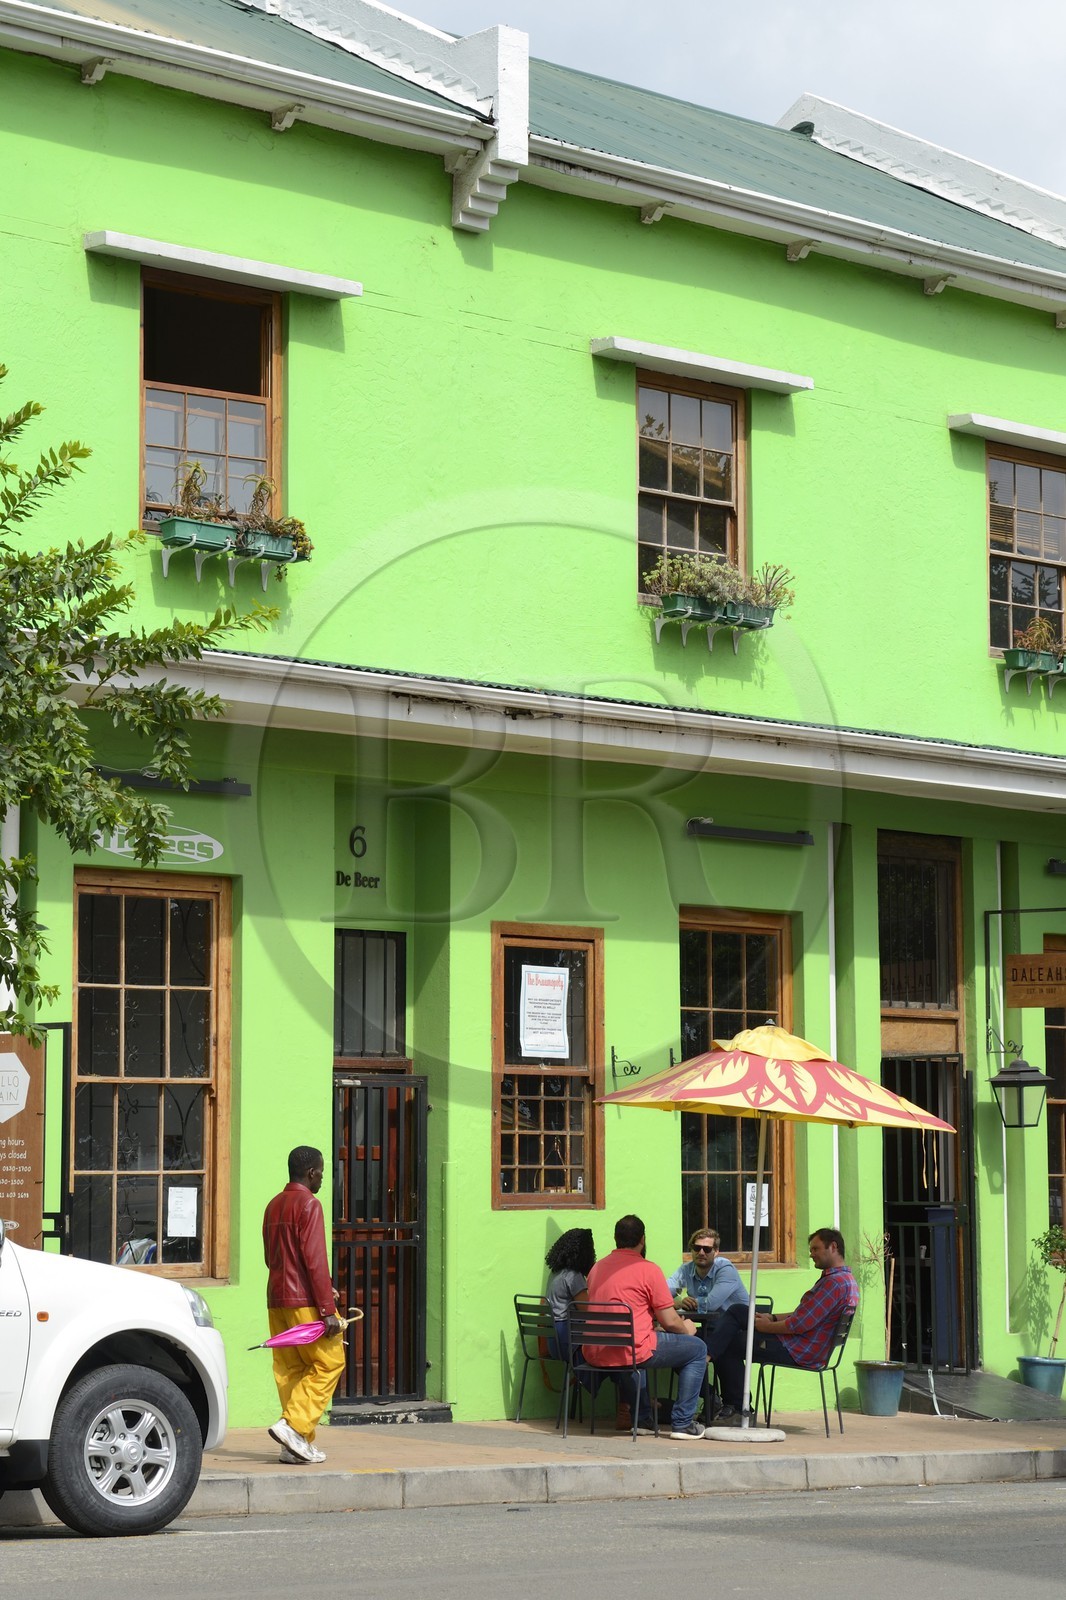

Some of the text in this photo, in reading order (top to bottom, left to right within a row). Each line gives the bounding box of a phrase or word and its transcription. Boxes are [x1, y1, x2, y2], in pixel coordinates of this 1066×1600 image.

[349, 825, 367, 858] 6
[336, 870, 380, 888] De Beer
[1012, 967, 1066, 982] DALEAH
[8, 1137, 25, 1146] hours
[8, 1150, 27, 1159] closed
